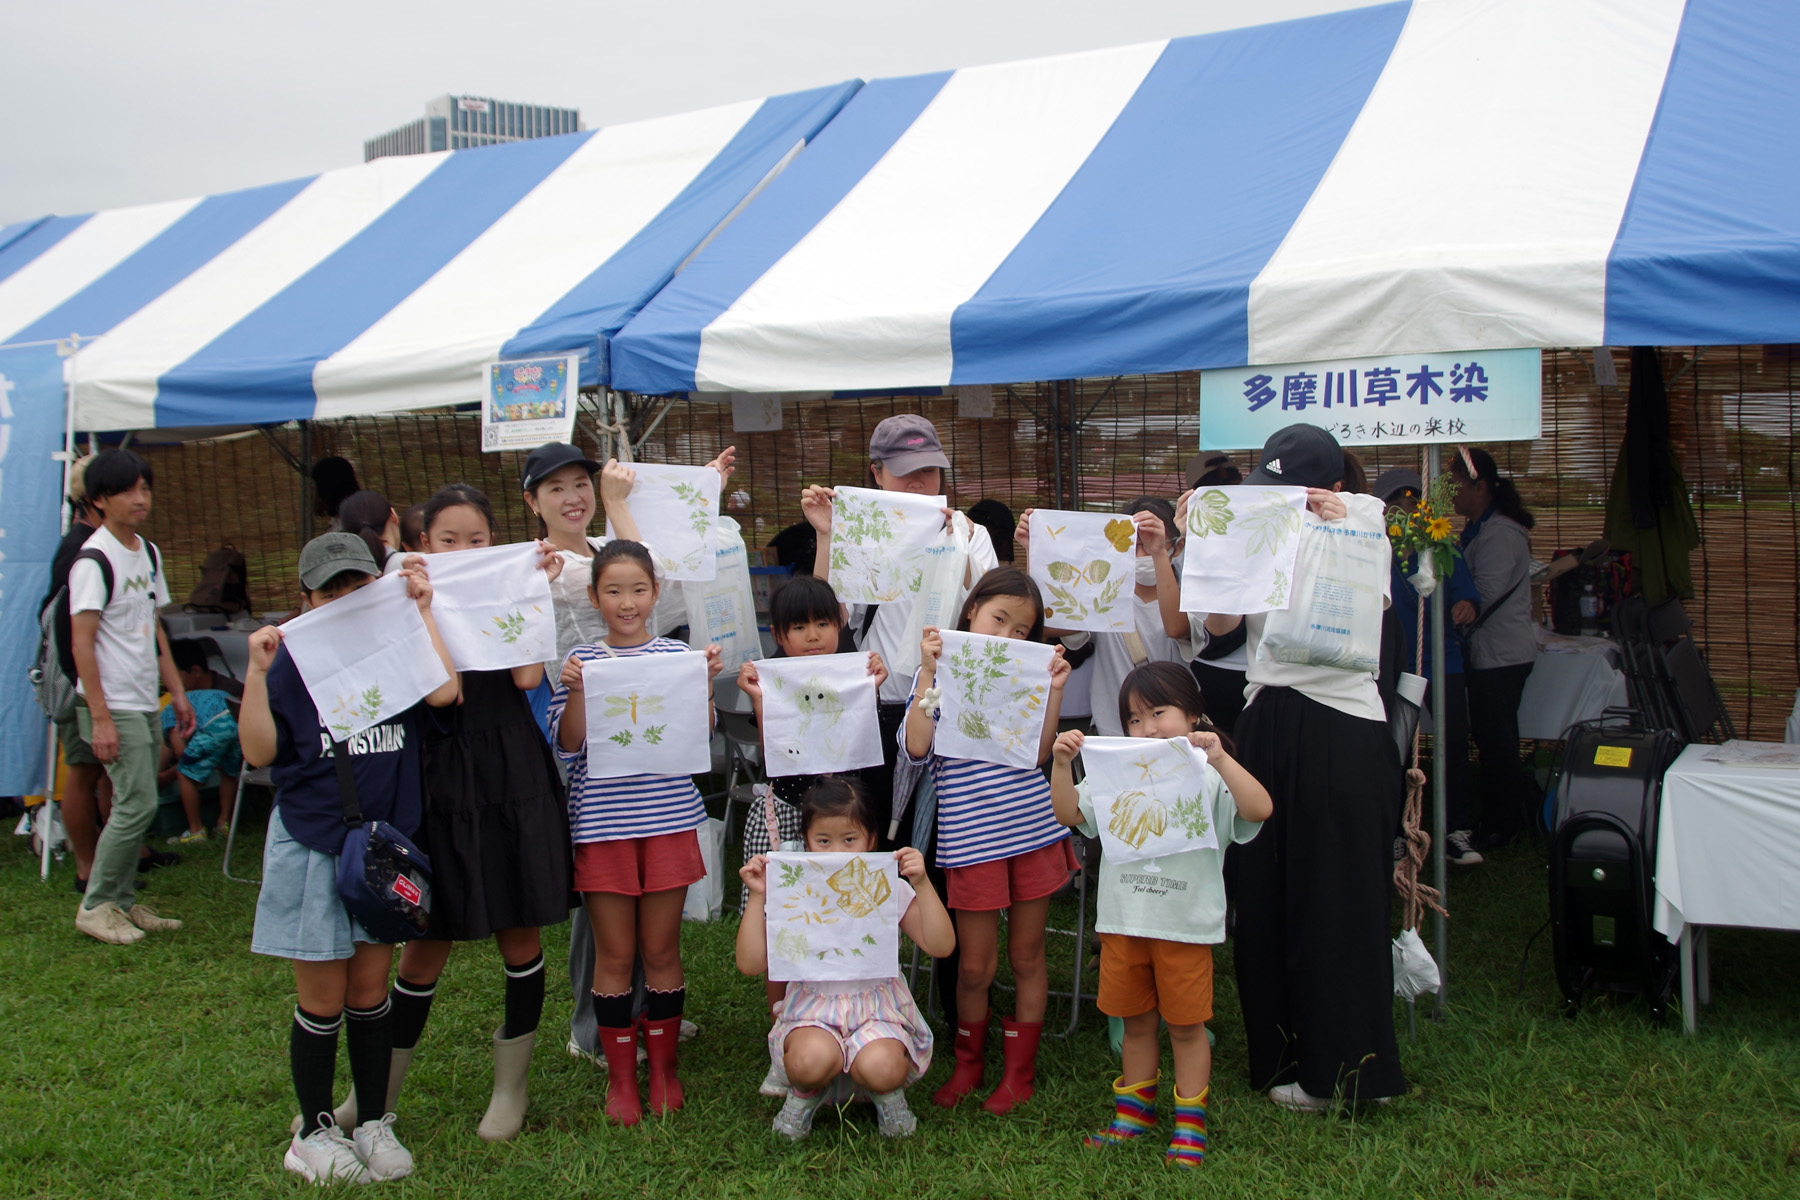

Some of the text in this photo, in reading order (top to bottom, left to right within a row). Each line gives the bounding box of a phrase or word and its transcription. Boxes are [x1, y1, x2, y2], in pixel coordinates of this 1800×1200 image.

[1243, 362, 1489, 412] 多摩川草木染
[1120, 874, 1188, 890] SUPERB TIME
[1133, 885, 1145, 894] Feel
